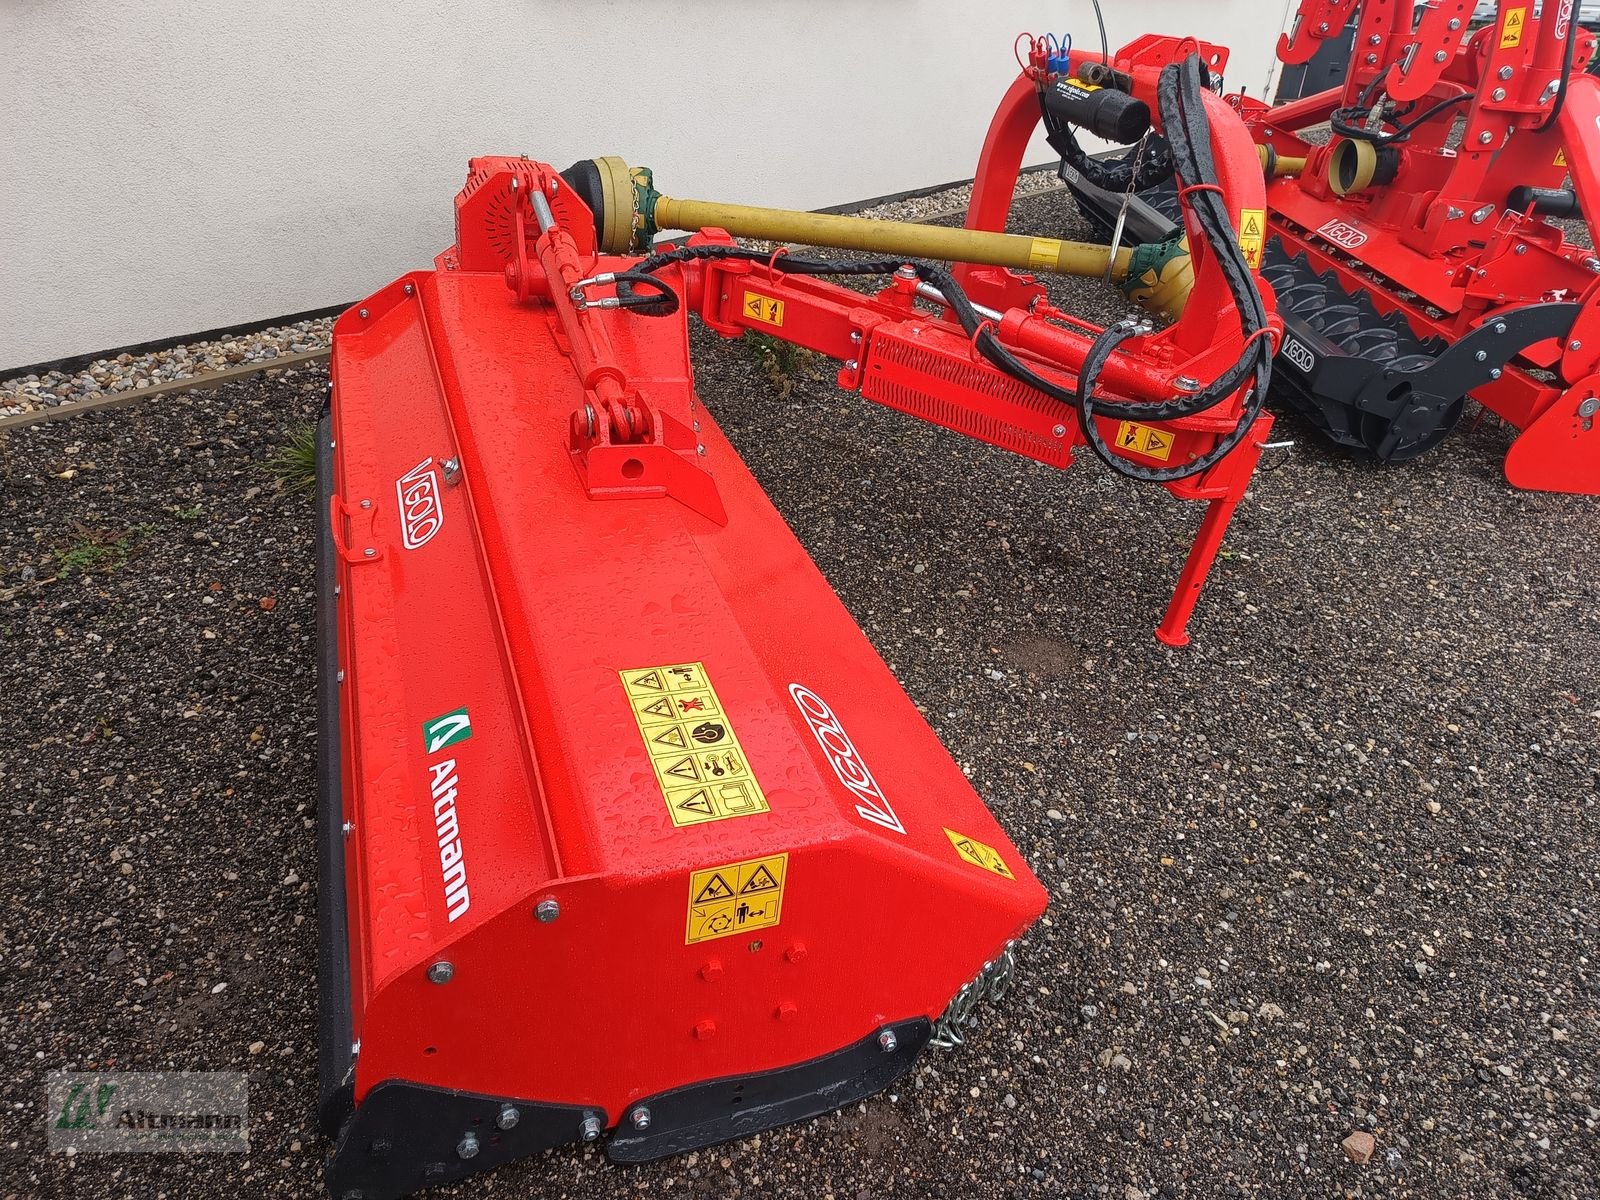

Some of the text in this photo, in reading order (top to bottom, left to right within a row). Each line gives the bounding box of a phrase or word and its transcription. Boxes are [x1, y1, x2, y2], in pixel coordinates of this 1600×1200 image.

[1316, 218, 1368, 249] VIGOLO
[1281, 334, 1315, 373] VIGOLO
[396, 456, 444, 550] VIGOLO
[788, 683, 906, 835] VIGOLO
[428, 759, 471, 923] Altmann
